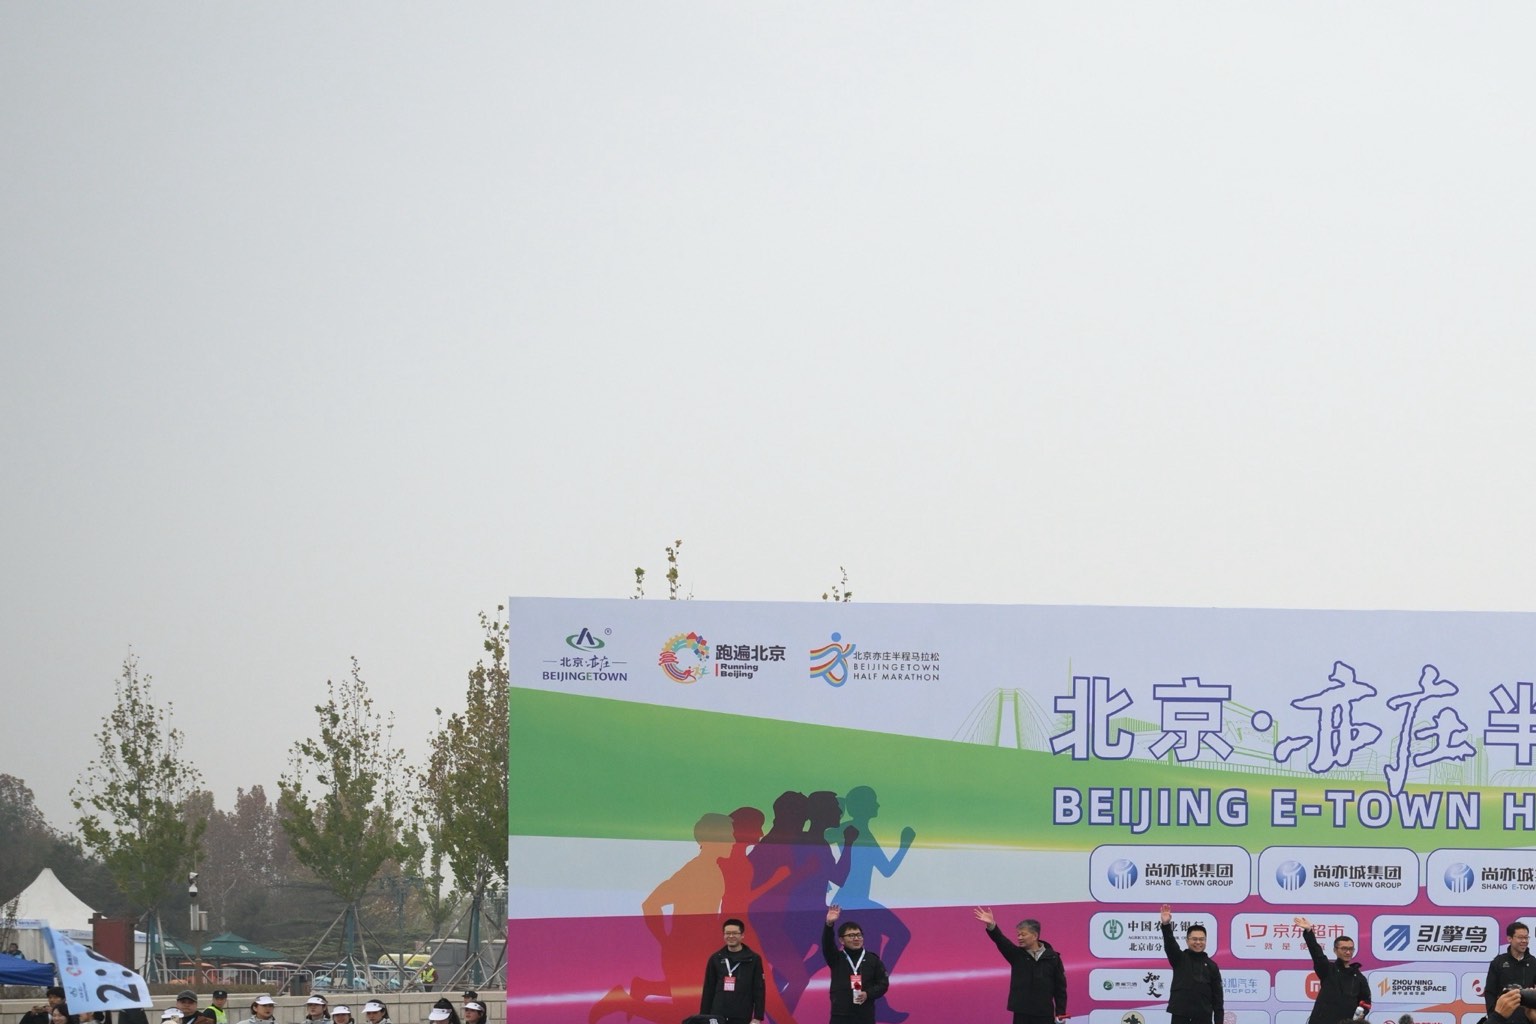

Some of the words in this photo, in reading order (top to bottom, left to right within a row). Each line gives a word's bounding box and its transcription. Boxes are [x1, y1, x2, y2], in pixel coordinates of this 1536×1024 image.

[715, 644, 786, 662] 跑遍北京
[853, 651, 940, 662] 北京亦庄半程马拉松
[720, 663, 759, 672] Running
[853, 663, 940, 672] BEIJINGETOWN
[542, 671, 628, 682] BEIJINGETOWN
[720, 670, 754, 680] Beijing
[853, 672, 878, 681] HALF
[881, 672, 940, 682] MARATHON
[1053, 787, 1248, 834] BEIJING
[1270, 788, 1480, 830] E-TOWN
[1145, 863, 1234, 878] 尚亦城集团
[1313, 864, 1402, 880] 尚亦城集团
[1145, 879, 1172, 887] SHANG
[1176, 879, 1205, 887] E-TOWN
[1207, 880, 1234, 888] GROUP
[1313, 880, 1340, 888] SHANG
[1375, 881, 1402, 889] GROUP
[1481, 883, 1508, 891] SHANG
[1128, 920, 1204, 932] 中国农业银
[1417, 925, 1488, 943] 引擎鸟
[1128, 942, 1165, 952] 北京市分
[1416, 944, 1488, 953] ENGINEBIRD
